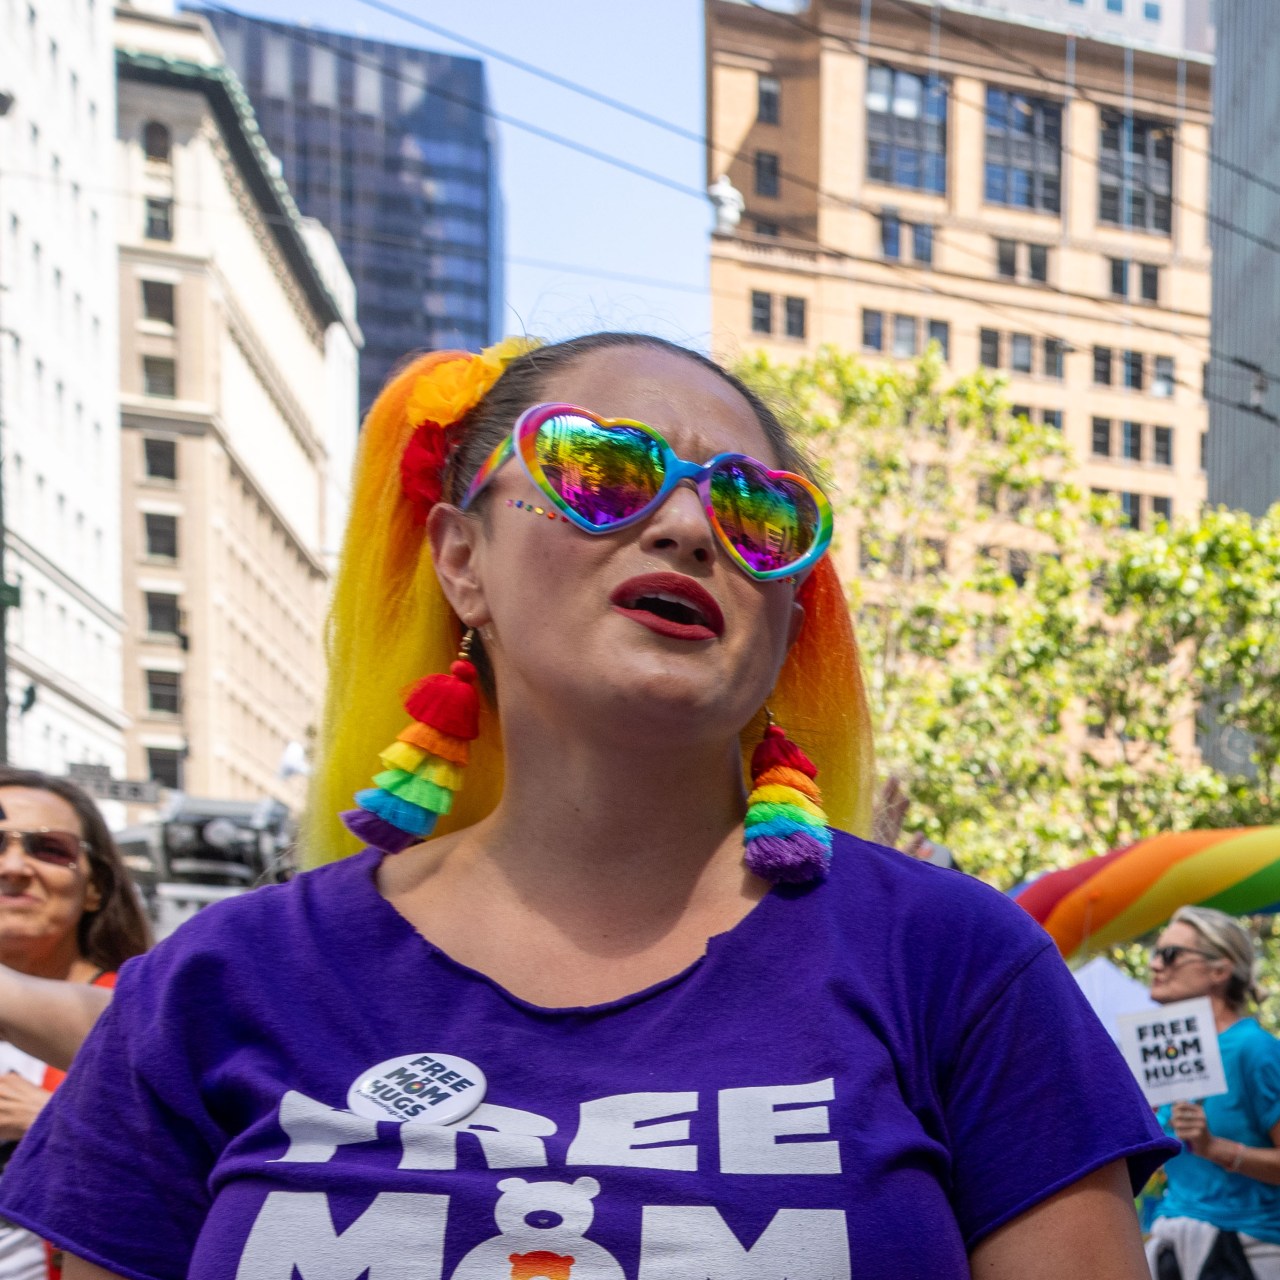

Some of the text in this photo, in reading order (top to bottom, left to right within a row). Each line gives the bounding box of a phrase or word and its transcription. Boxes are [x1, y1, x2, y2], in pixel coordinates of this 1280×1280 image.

[1137, 1016, 1198, 1042] FREE
[1141, 1037, 1201, 1063] MOM
[383, 1066, 452, 1106] MOM
[408, 1055, 476, 1092] FREE
[1144, 1058, 1206, 1082] HUGS
[370, 1079, 428, 1116] HUGS
[265, 1078, 843, 1175] FREE
